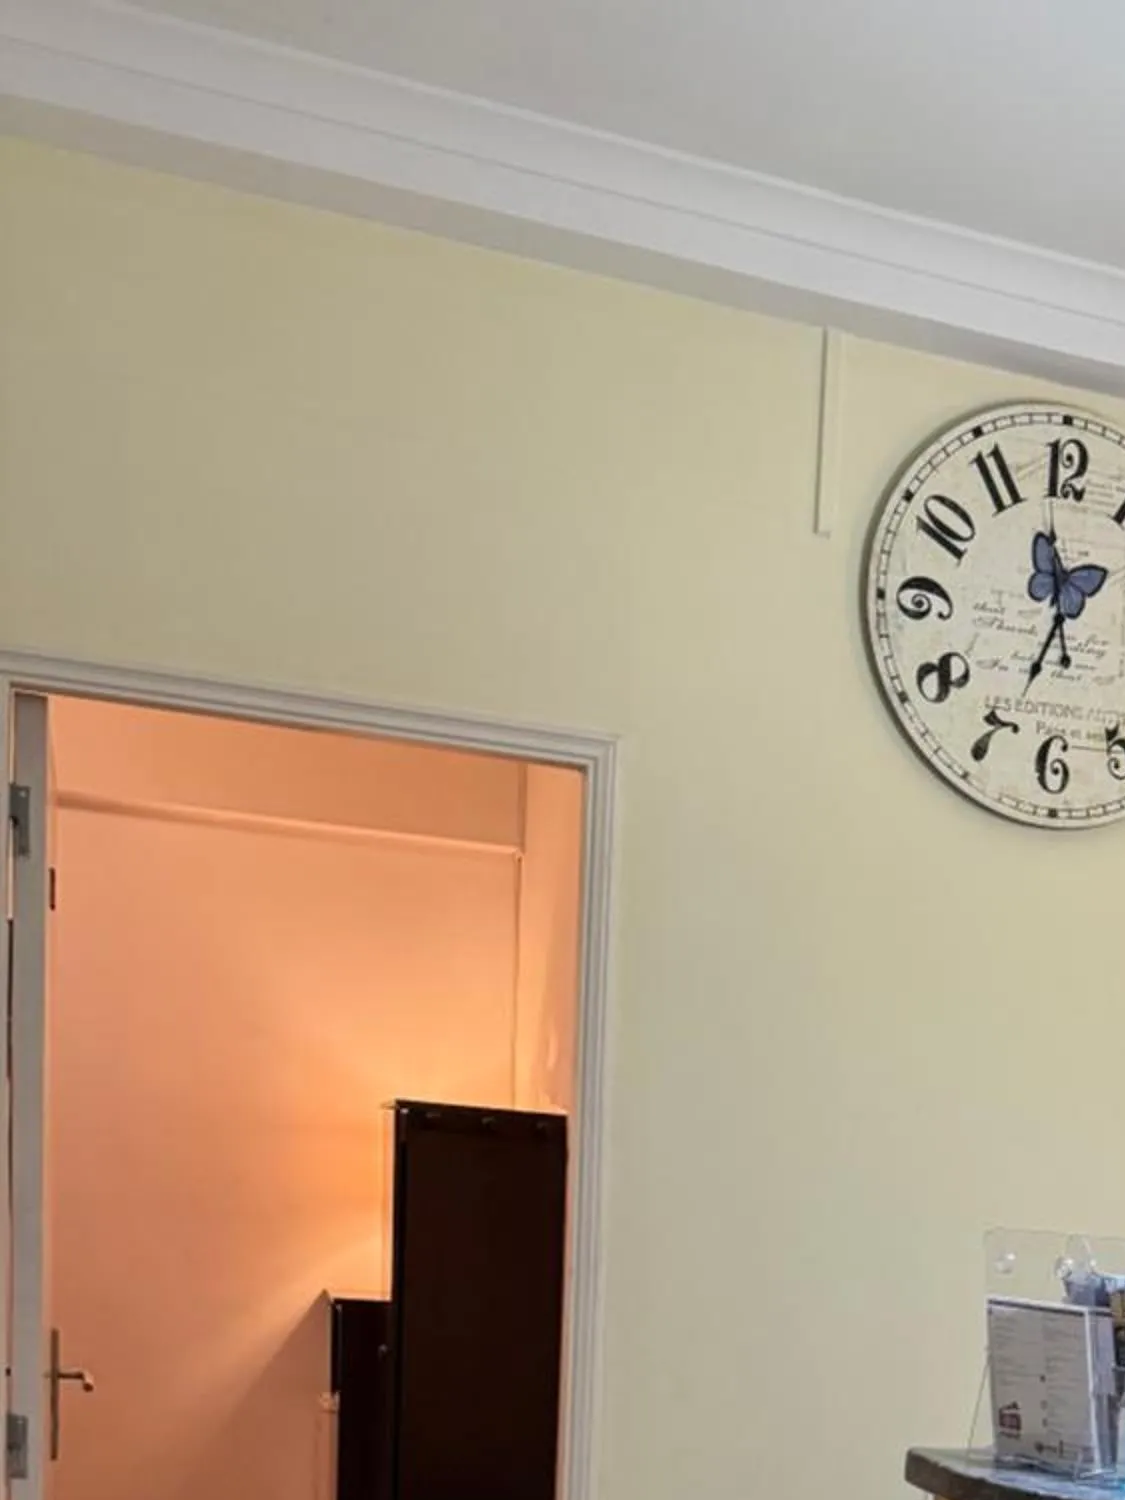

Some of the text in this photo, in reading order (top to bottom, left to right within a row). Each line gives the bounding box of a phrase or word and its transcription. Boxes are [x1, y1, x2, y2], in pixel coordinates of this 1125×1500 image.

[970, 442, 1028, 517] 11
[1044, 438, 1089, 502] 12
[916, 494, 976, 565] 10
[896, 576, 953, 621] 9
[915, 651, 971, 704] 8
[971, 708, 1019, 762] 7
[1034, 735, 1070, 794] 6
